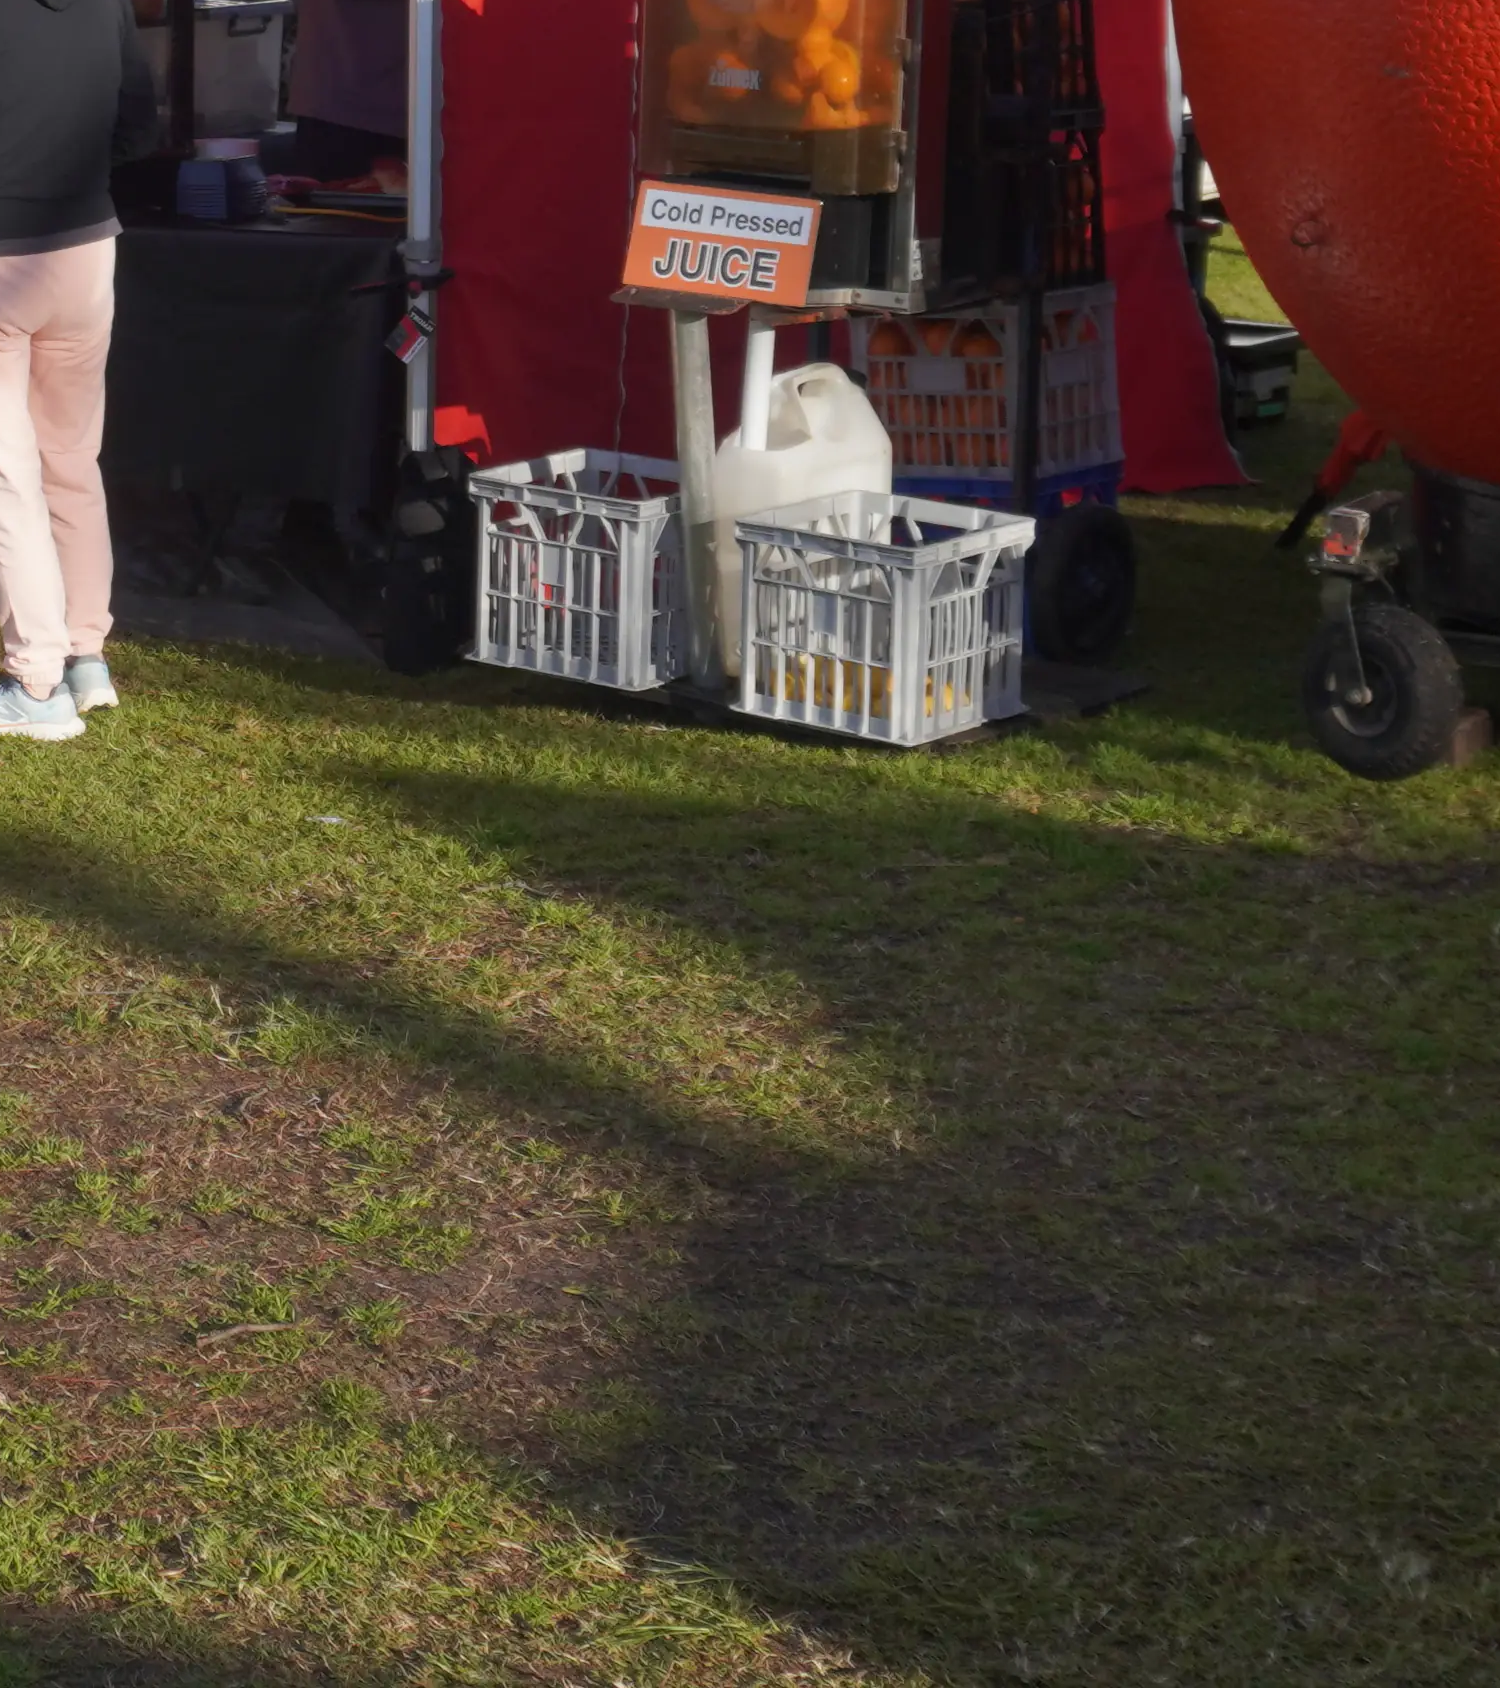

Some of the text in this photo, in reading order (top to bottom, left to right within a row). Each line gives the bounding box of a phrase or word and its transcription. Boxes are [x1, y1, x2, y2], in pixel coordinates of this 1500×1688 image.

[651, 198, 804, 237] Cold Pressed
[652, 236, 780, 292] JUICE
